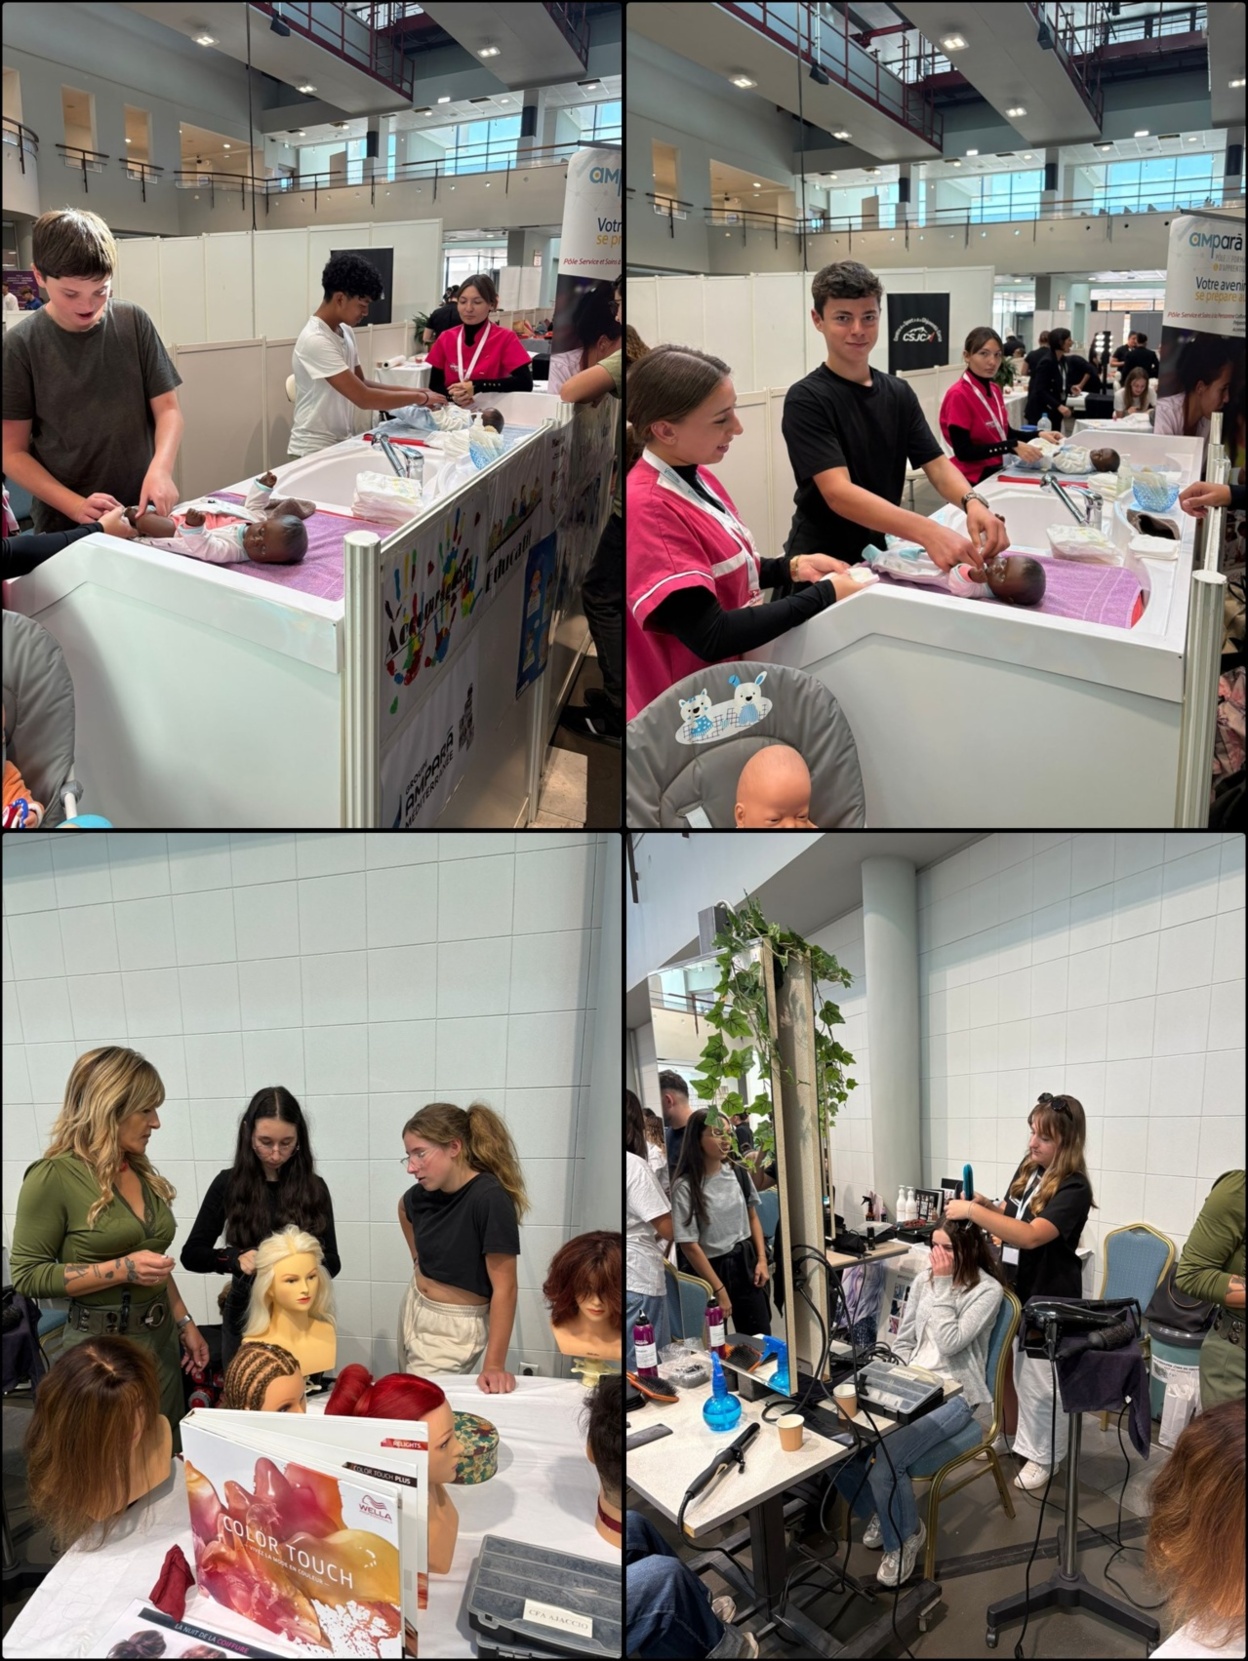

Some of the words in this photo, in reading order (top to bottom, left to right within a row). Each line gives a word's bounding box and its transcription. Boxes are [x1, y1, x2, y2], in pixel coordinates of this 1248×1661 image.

[1196, 276, 1219, 291] Votre
[1195, 291, 1204, 301] se
[903, 333, 927, 342] CSJC
[393, 1441, 421, 1449] RELIGHTS
[353, 1465, 373, 1476] COLOR
[374, 1470, 394, 1481] TOUCH
[395, 1475, 411, 1485] PLUS
[359, 1504, 392, 1520] WELLA
[223, 1515, 279, 1554] COLOR
[286, 1544, 353, 1589] TOUCH
[529, 1609, 546, 1618] CFA
[549, 1615, 588, 1630] AJACCIO
[174, 1623, 182, 1631] LA
[183, 1626, 198, 1636] NUIT
[199, 1631, 207, 1639] DE
[208, 1634, 217, 1642] LA
[217, 1638, 249, 1654] COIFFURE
